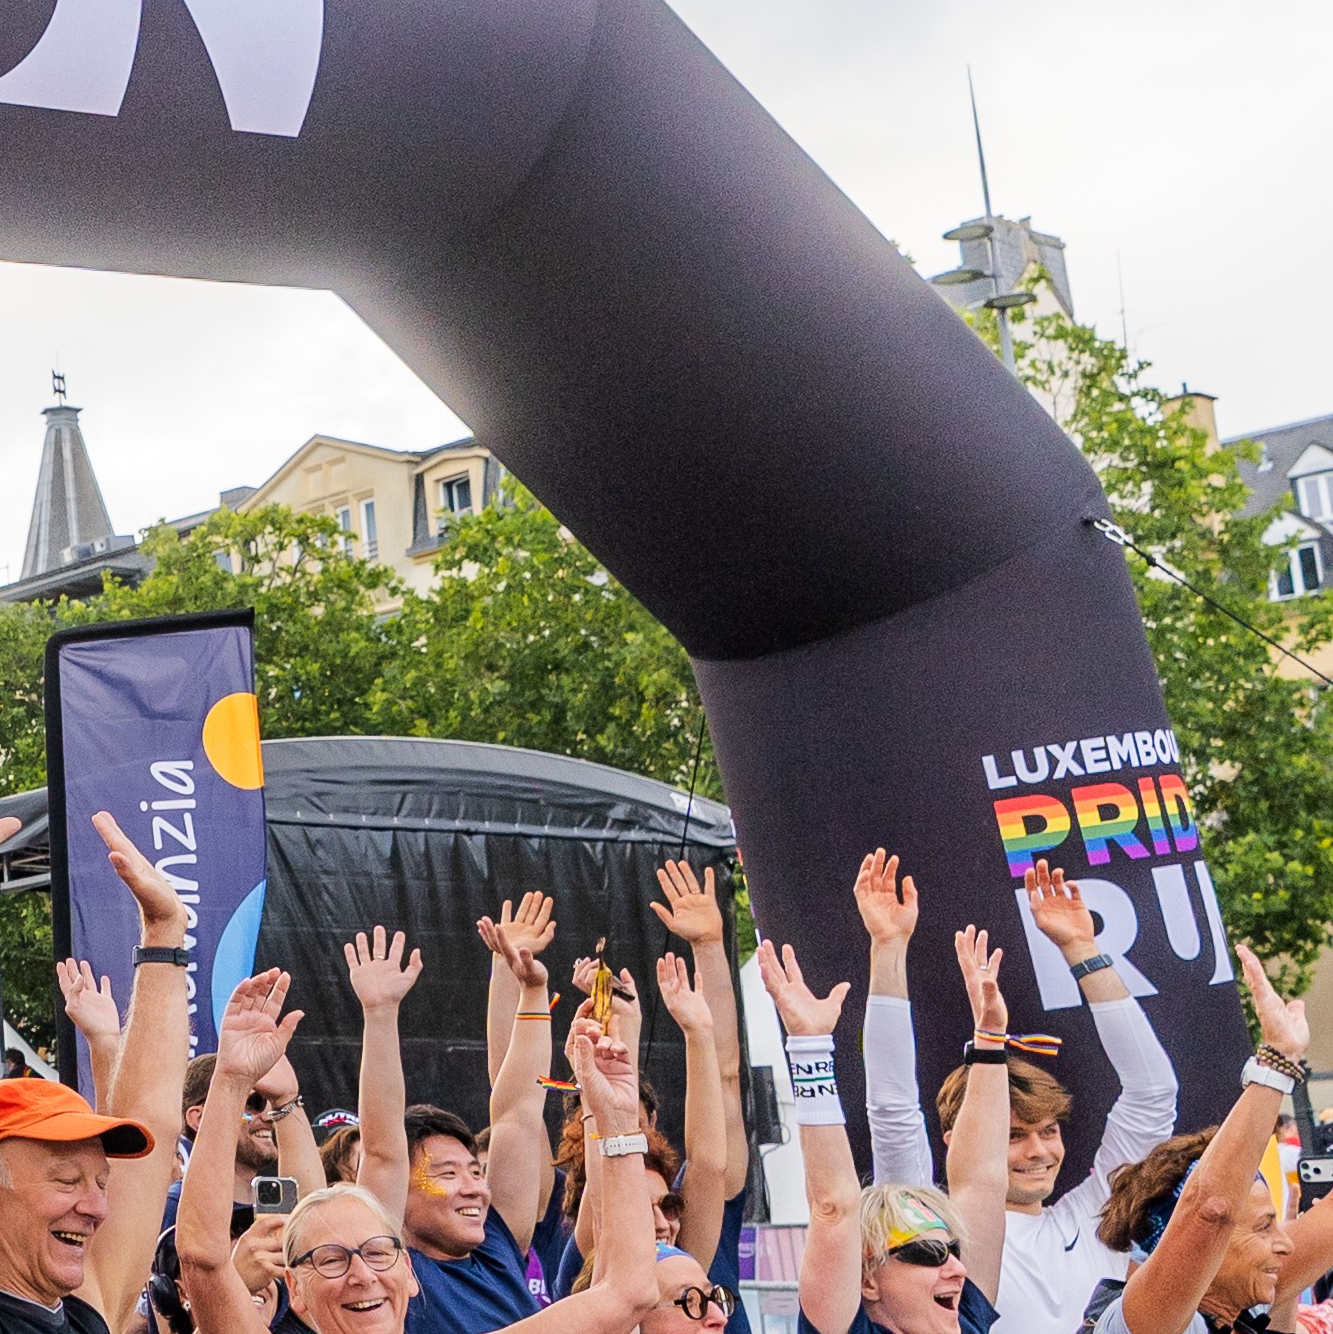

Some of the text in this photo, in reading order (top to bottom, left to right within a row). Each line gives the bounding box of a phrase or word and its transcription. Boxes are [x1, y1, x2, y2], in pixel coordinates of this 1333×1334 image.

[981, 729, 1180, 790] LUXEMBOU
[993, 774, 1198, 878] PRID
[1015, 860, 1234, 1011] RU
